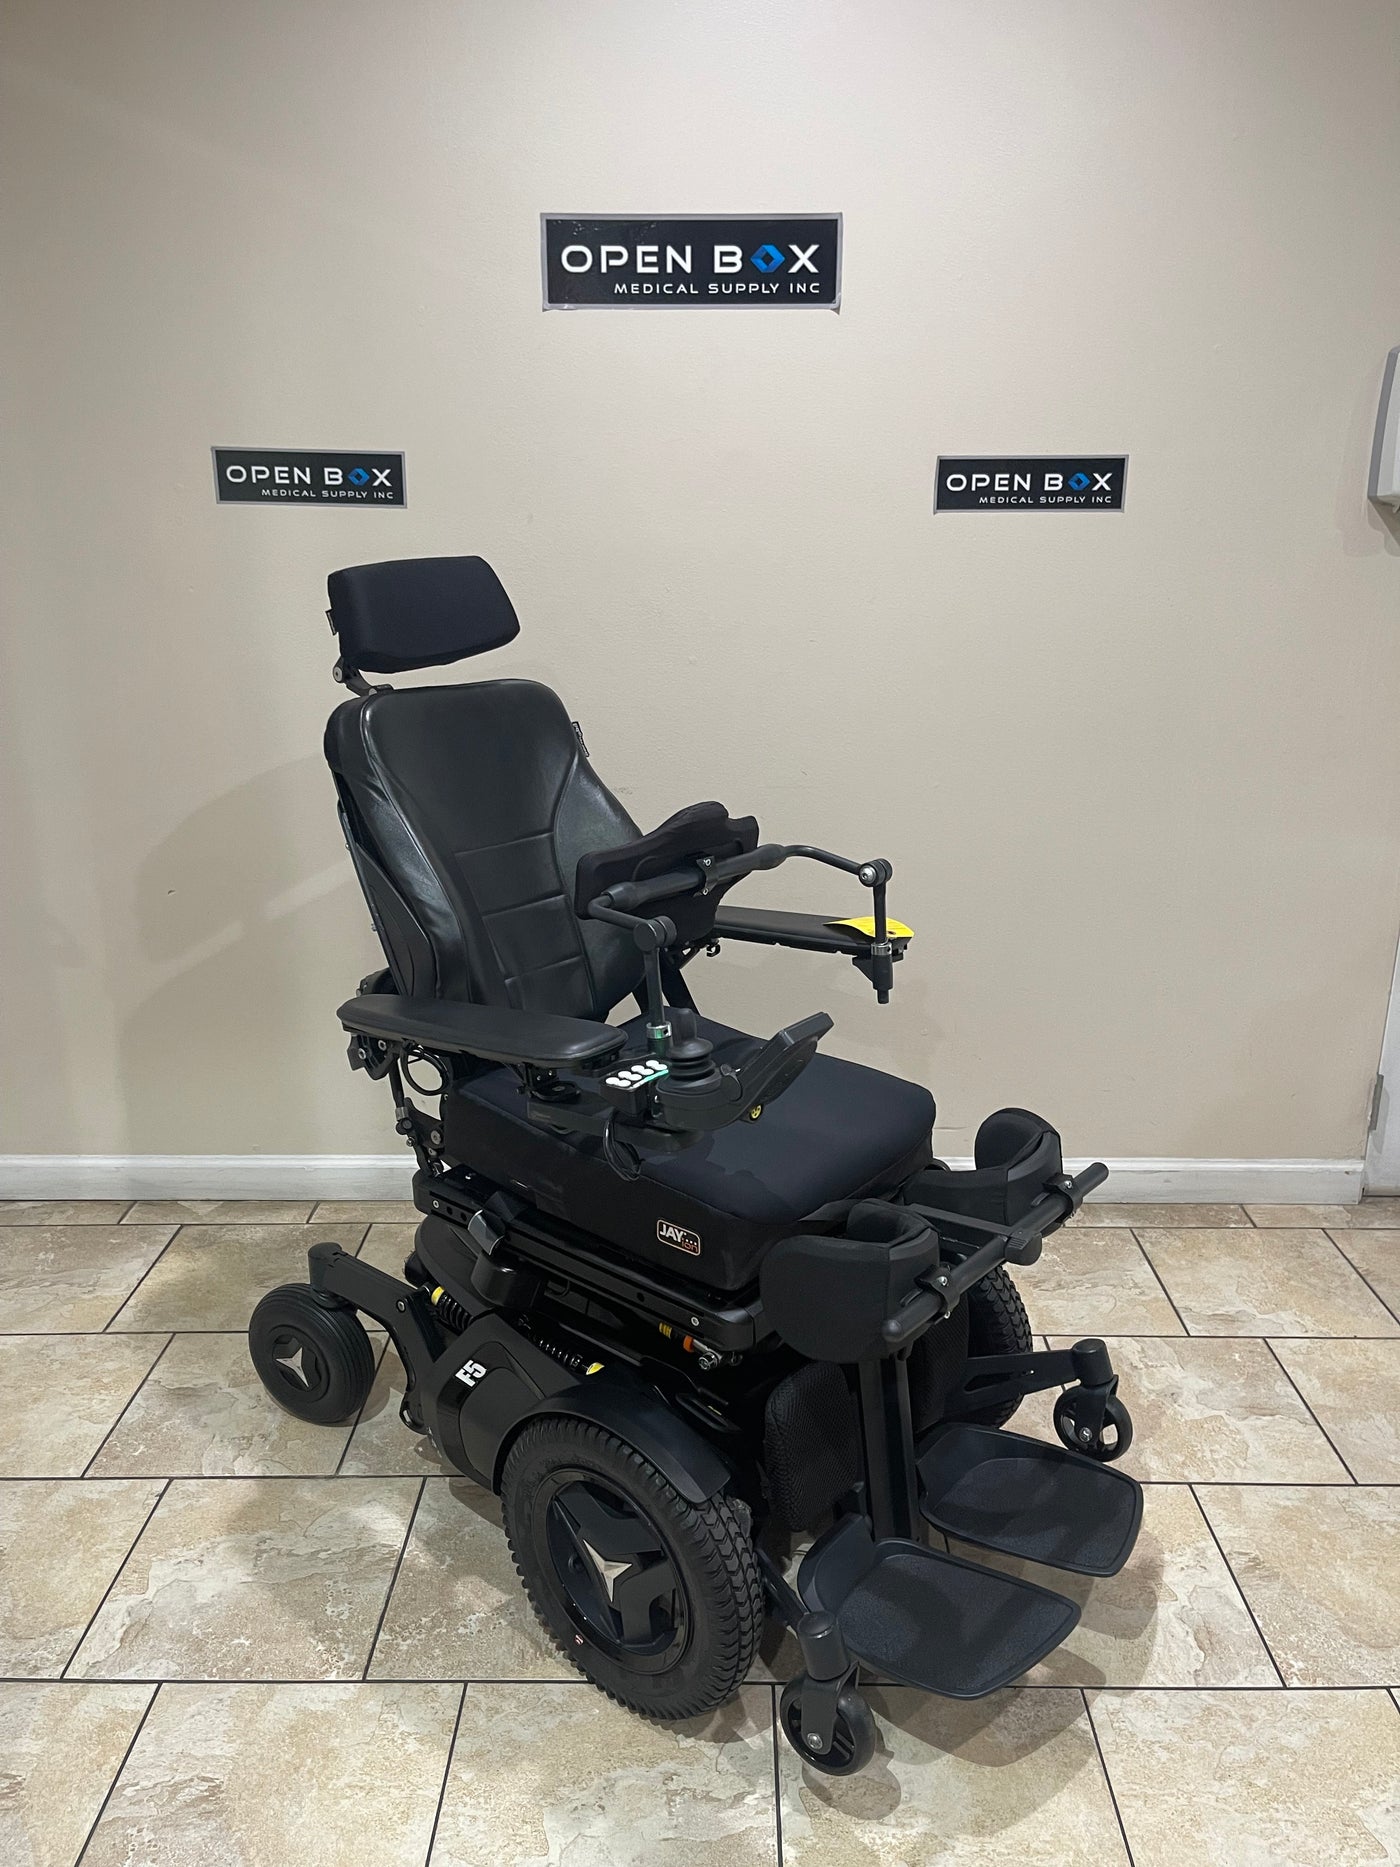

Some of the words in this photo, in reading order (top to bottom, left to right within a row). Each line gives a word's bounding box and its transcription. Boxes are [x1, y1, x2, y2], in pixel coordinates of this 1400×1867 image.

[561, 245, 692, 274] OPEN
[713, 244, 820, 274] BOX
[614, 283, 699, 294] MEDICAL
[708, 283, 779, 294] SUPPLY
[789, 283, 820, 294] INC
[226, 465, 311, 485] OPEN
[324, 467, 392, 487] BOX
[946, 473, 1031, 492] OPEN
[1044, 472, 1112, 492] BOX
[261, 489, 316, 497] MEDICAL
[322, 490, 368, 499] SUPPLY
[373, 491, 394, 500] INC
[979, 496, 1034, 505] MEDICAL
[1039, 496, 1086, 504] SUPPLY
[1092, 496, 1112, 504] INC
[659, 1223, 684, 1243] JAY
[455, 1359, 487, 1387] F5
